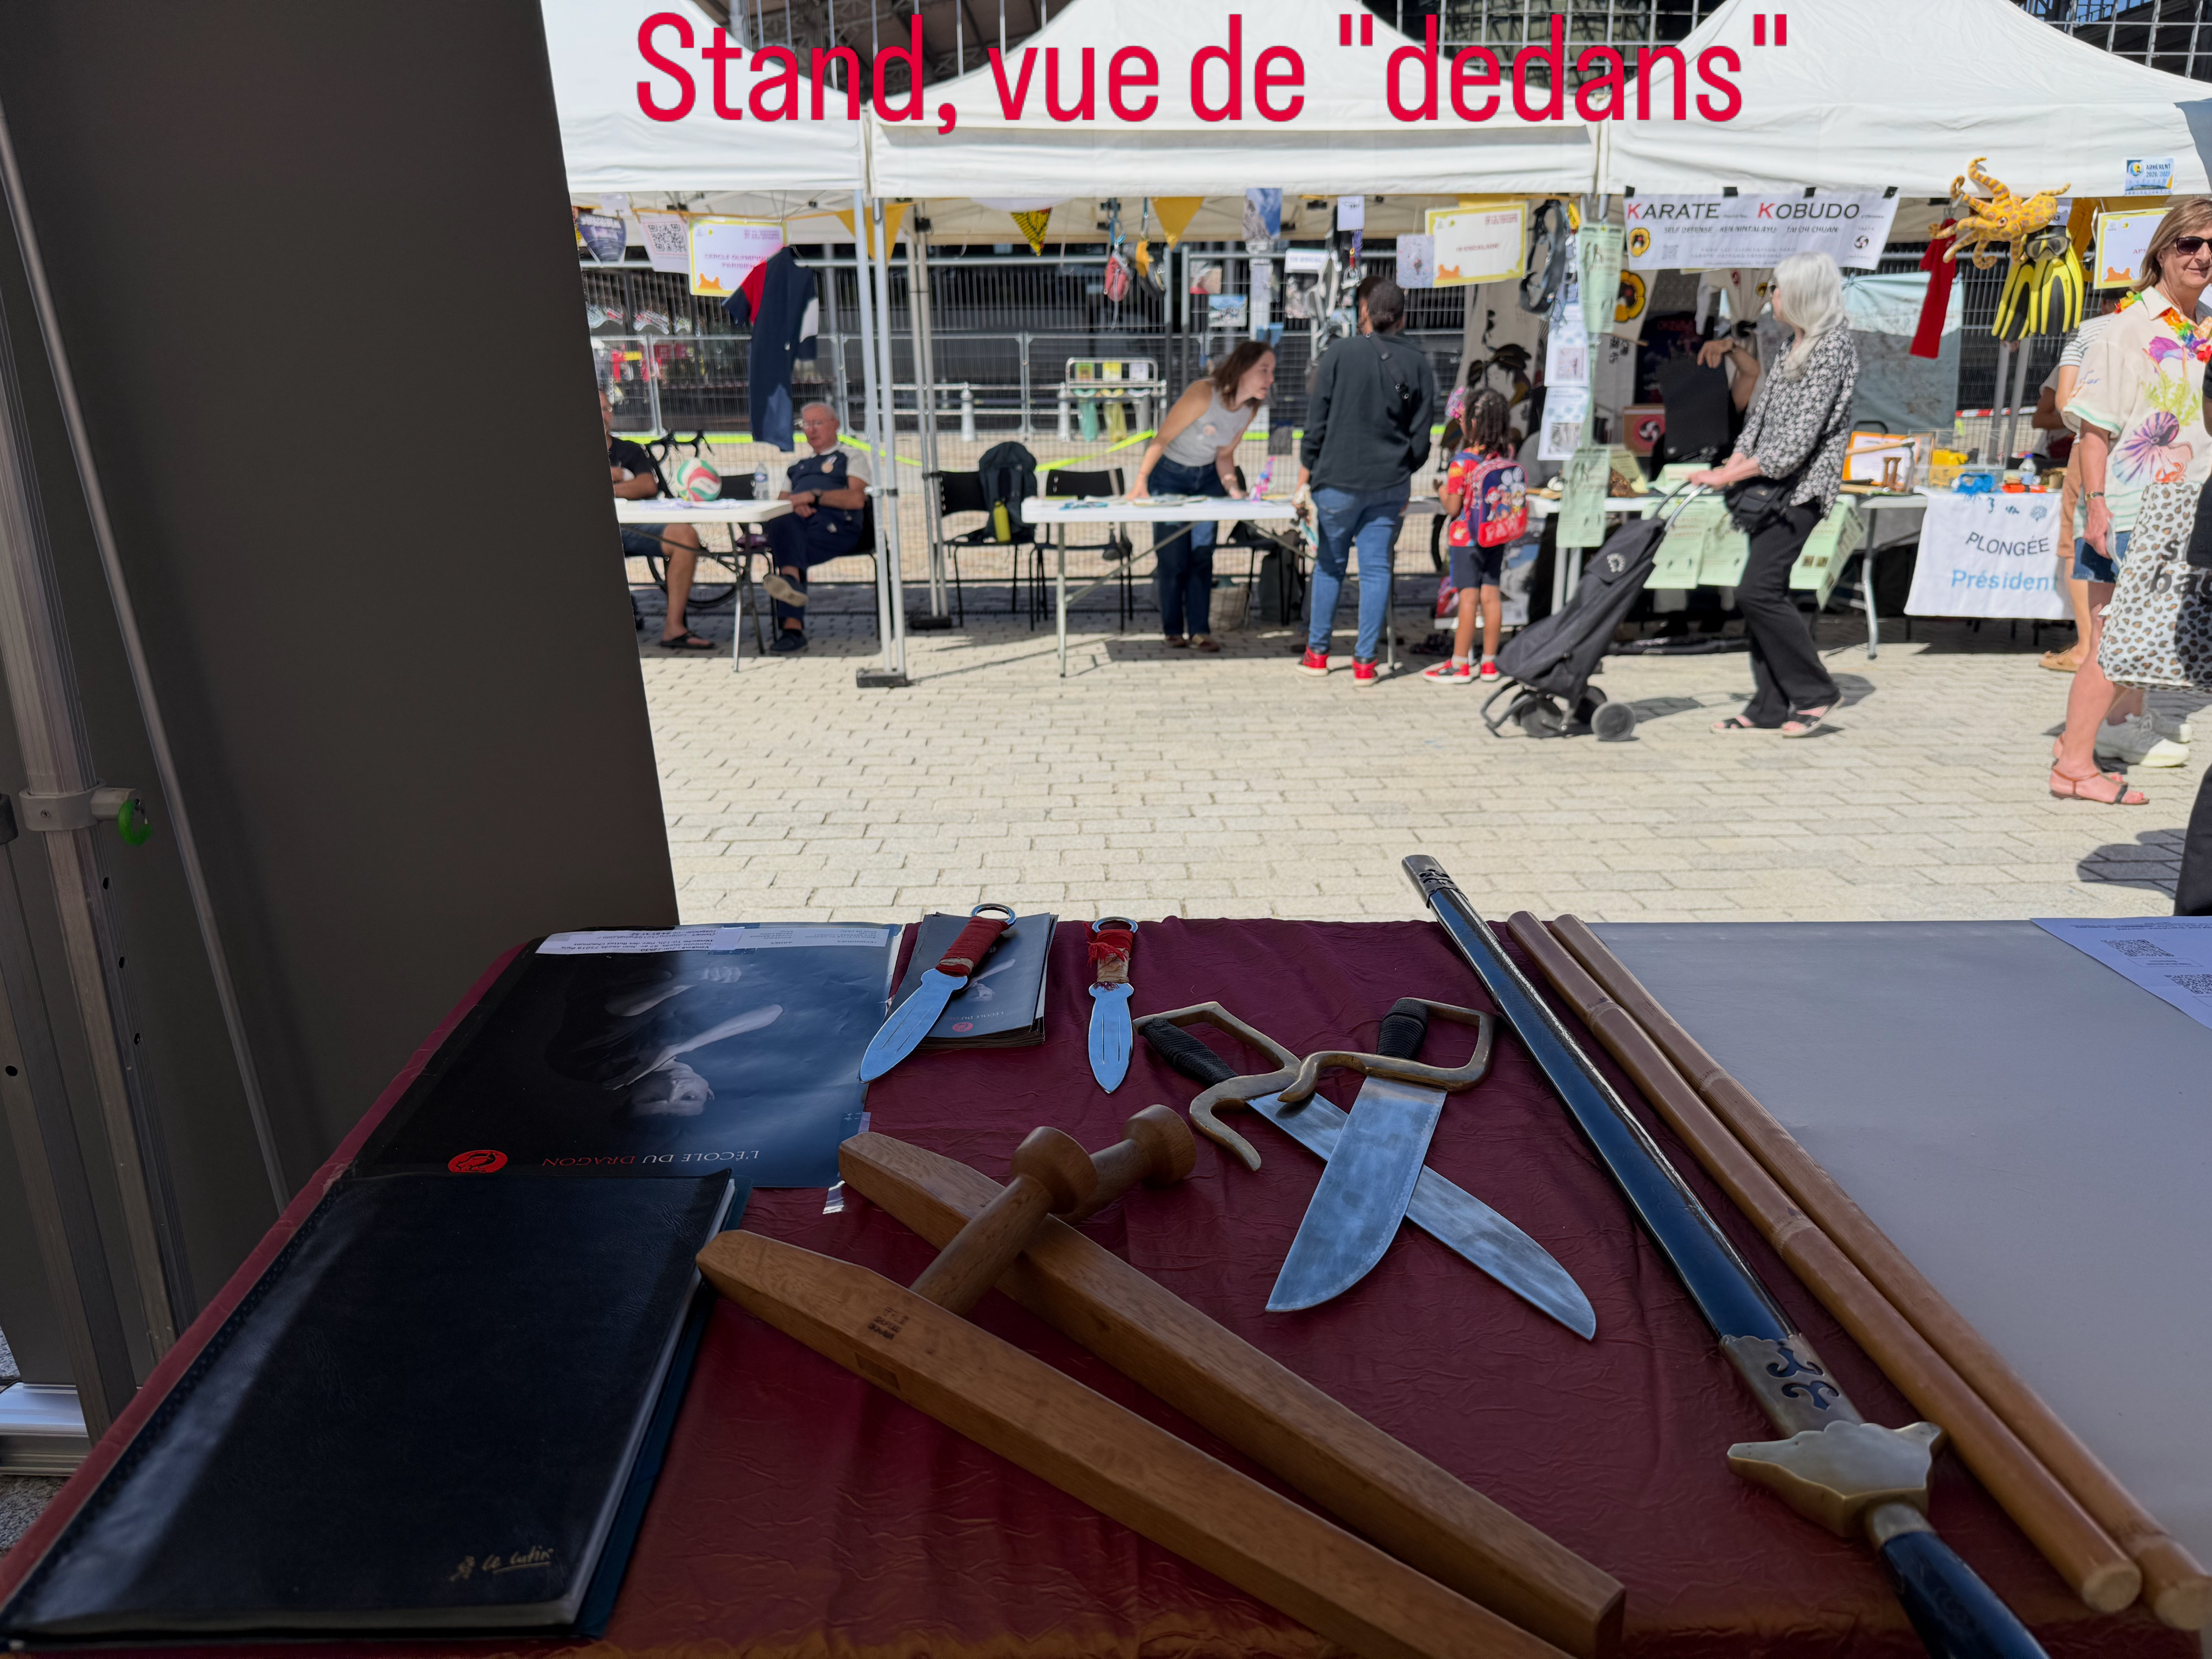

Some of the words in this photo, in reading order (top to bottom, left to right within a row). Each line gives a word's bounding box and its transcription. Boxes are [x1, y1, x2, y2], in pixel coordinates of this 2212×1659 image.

[1627, 203, 1721, 219] KARATE
[1758, 203, 1859, 219] KOBUDO
[1663, 225, 1680, 233] SELF
[1811, 225, 1839, 233] CHUAN
[1966, 531, 2049, 556] PLONGÉE
[542, 1156, 635, 1166] DRAGON
[682, 1150, 759, 1162] L'ÉCOLE
